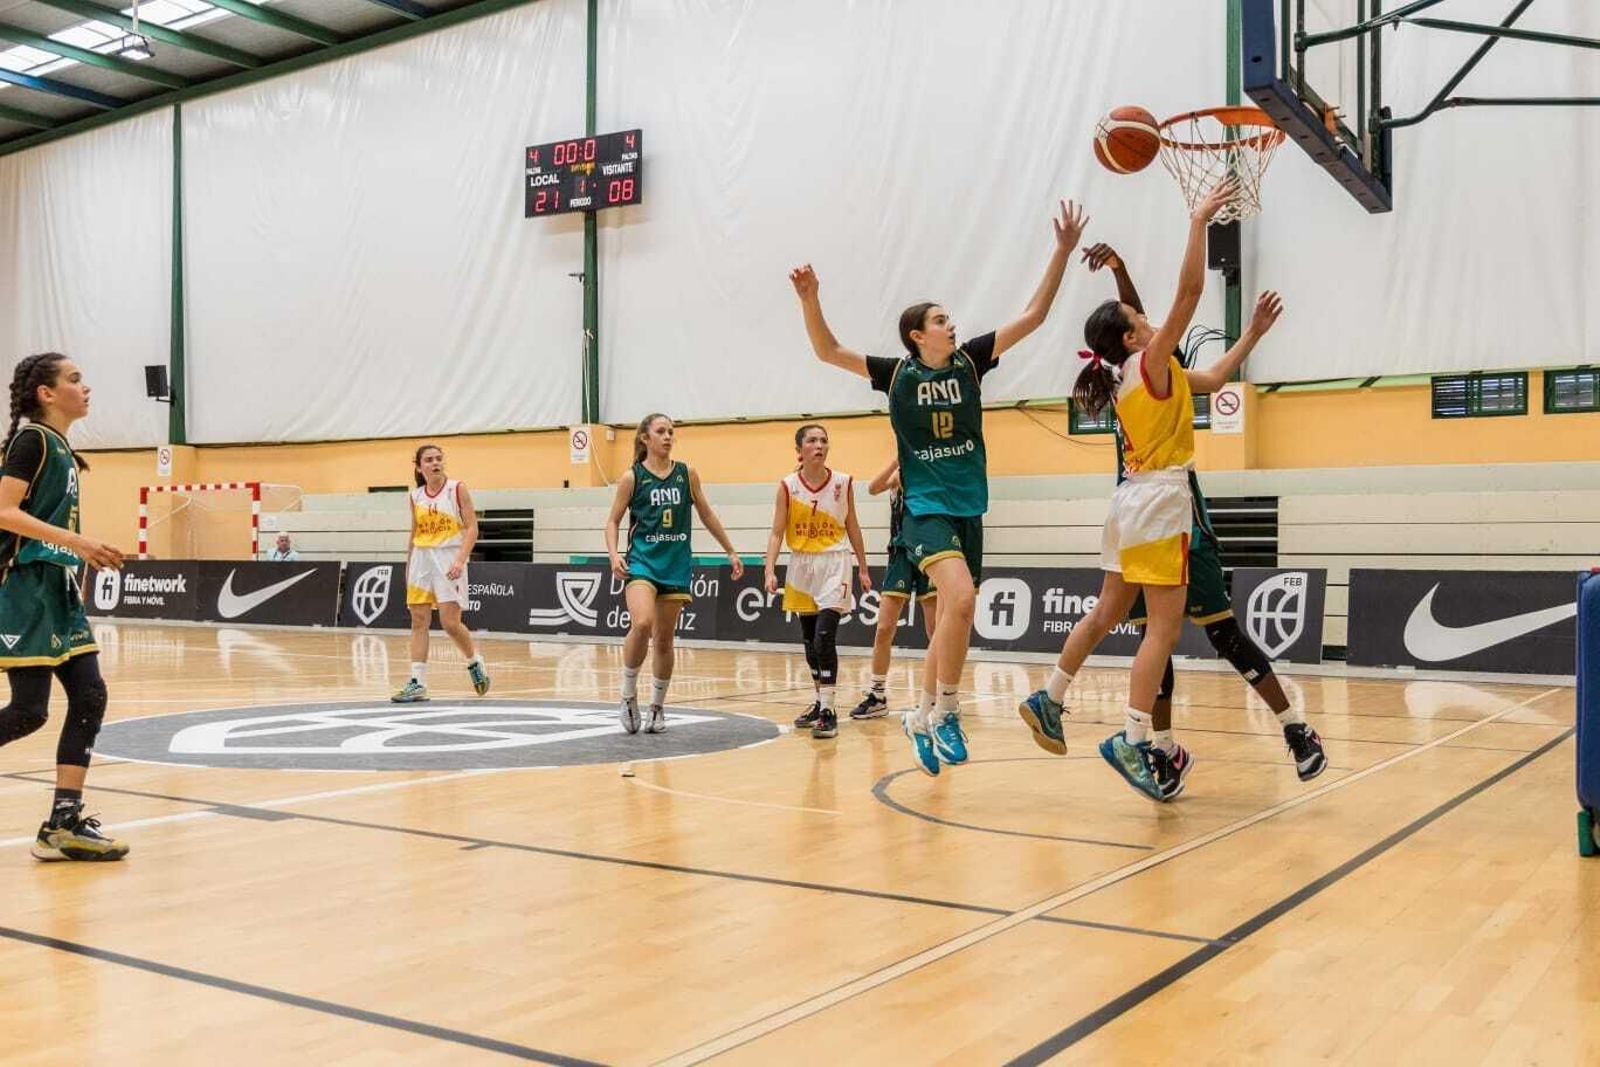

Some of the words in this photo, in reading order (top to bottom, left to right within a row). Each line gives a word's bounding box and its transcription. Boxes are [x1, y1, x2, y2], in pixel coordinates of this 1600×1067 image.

[626, 135, 635, 149] 4
[529, 149, 538, 163] 4
[554, 139, 595, 165] 00:0
[602, 162, 633, 176] VISITANTE
[530, 173, 559, 187] LOCAL
[608, 179, 633, 202] 08
[535, 190, 559, 213] 21
[917, 378, 962, 406] AND
[931, 411, 954, 439] 12
[650, 487, 681, 506] AND
[811, 499, 818, 517] 7
[662, 508, 673, 529] 9
[645, 532, 687, 544] cajasuro
[124, 573, 187, 593] finetwork
[841, 583, 848, 599] 7
[1283, 577, 1302, 587] FEB
[606, 605, 631, 629] de
[1043, 621, 1078, 633] FIBR
